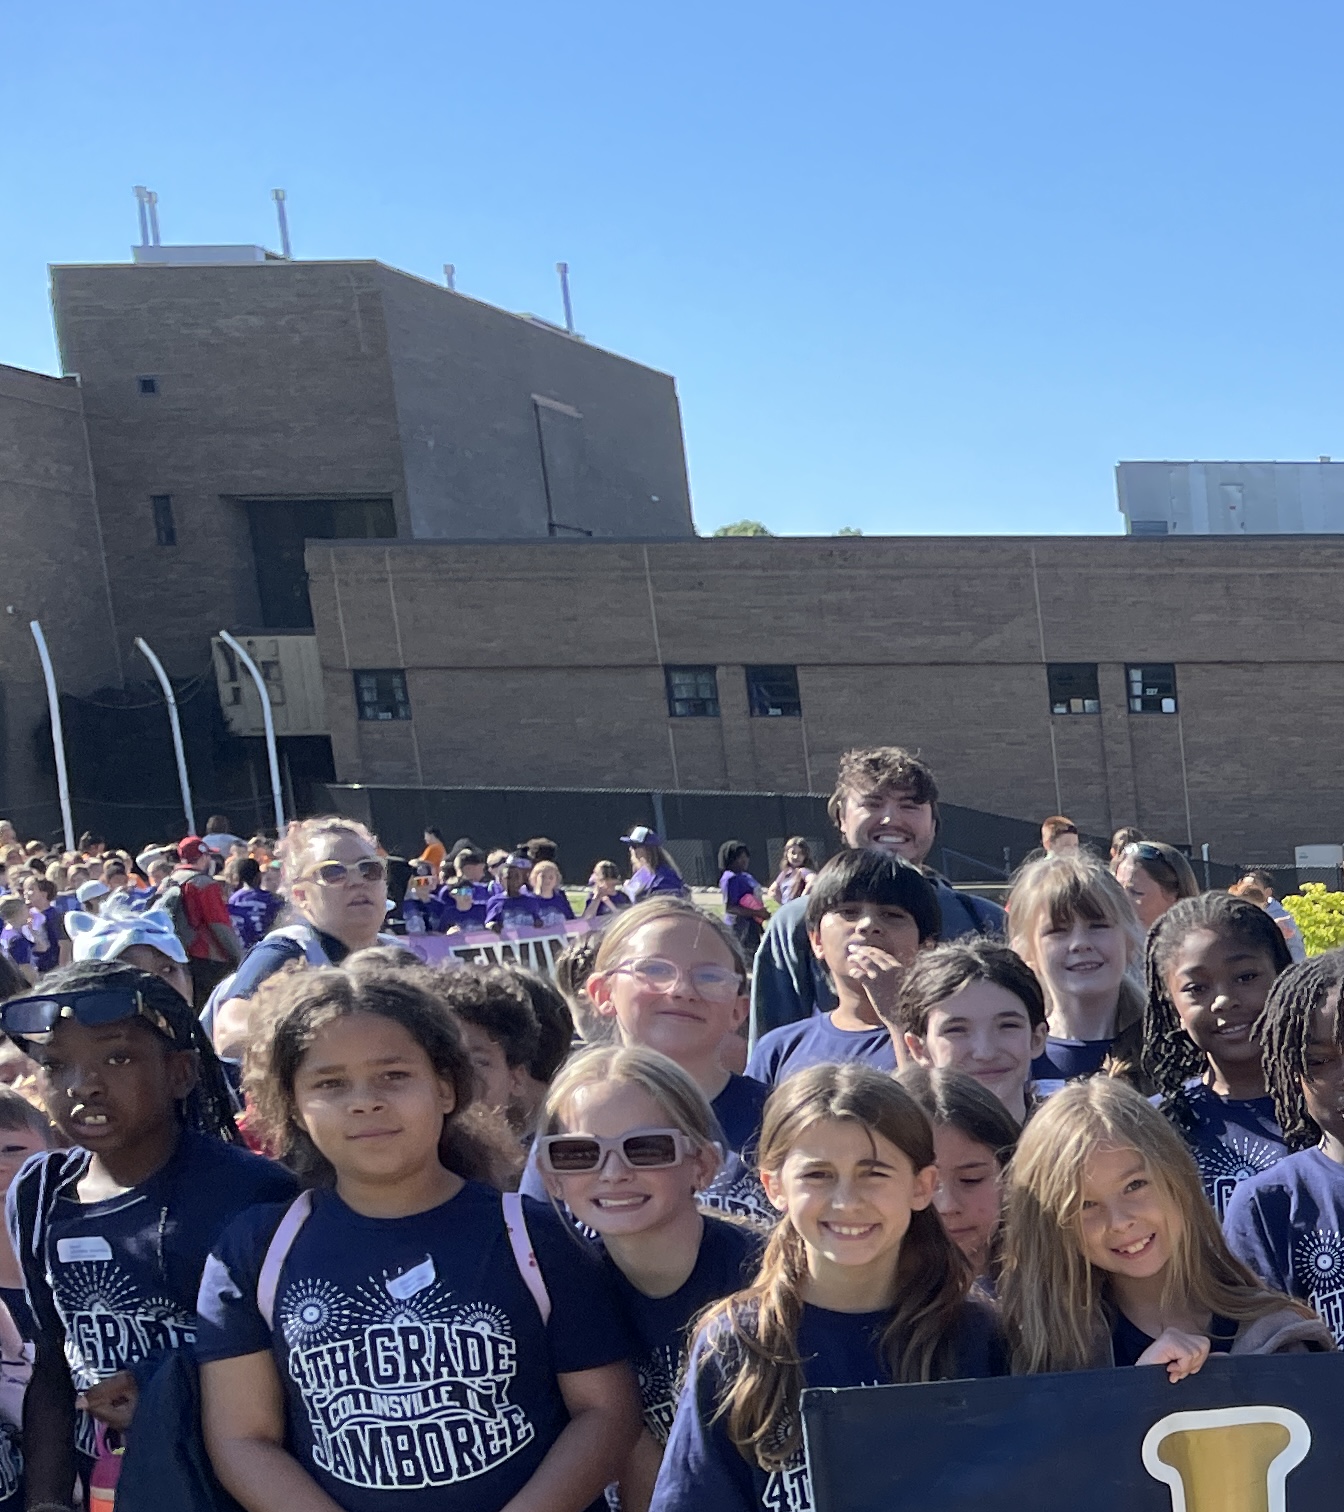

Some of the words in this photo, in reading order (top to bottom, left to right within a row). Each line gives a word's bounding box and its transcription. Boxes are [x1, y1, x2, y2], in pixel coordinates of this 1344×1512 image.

[72, 1310, 198, 1373] GRA
[288, 1339, 361, 1398] 4TH
[365, 1322, 518, 1388] GRADE
[312, 1404, 536, 1490] JAMBOREE
